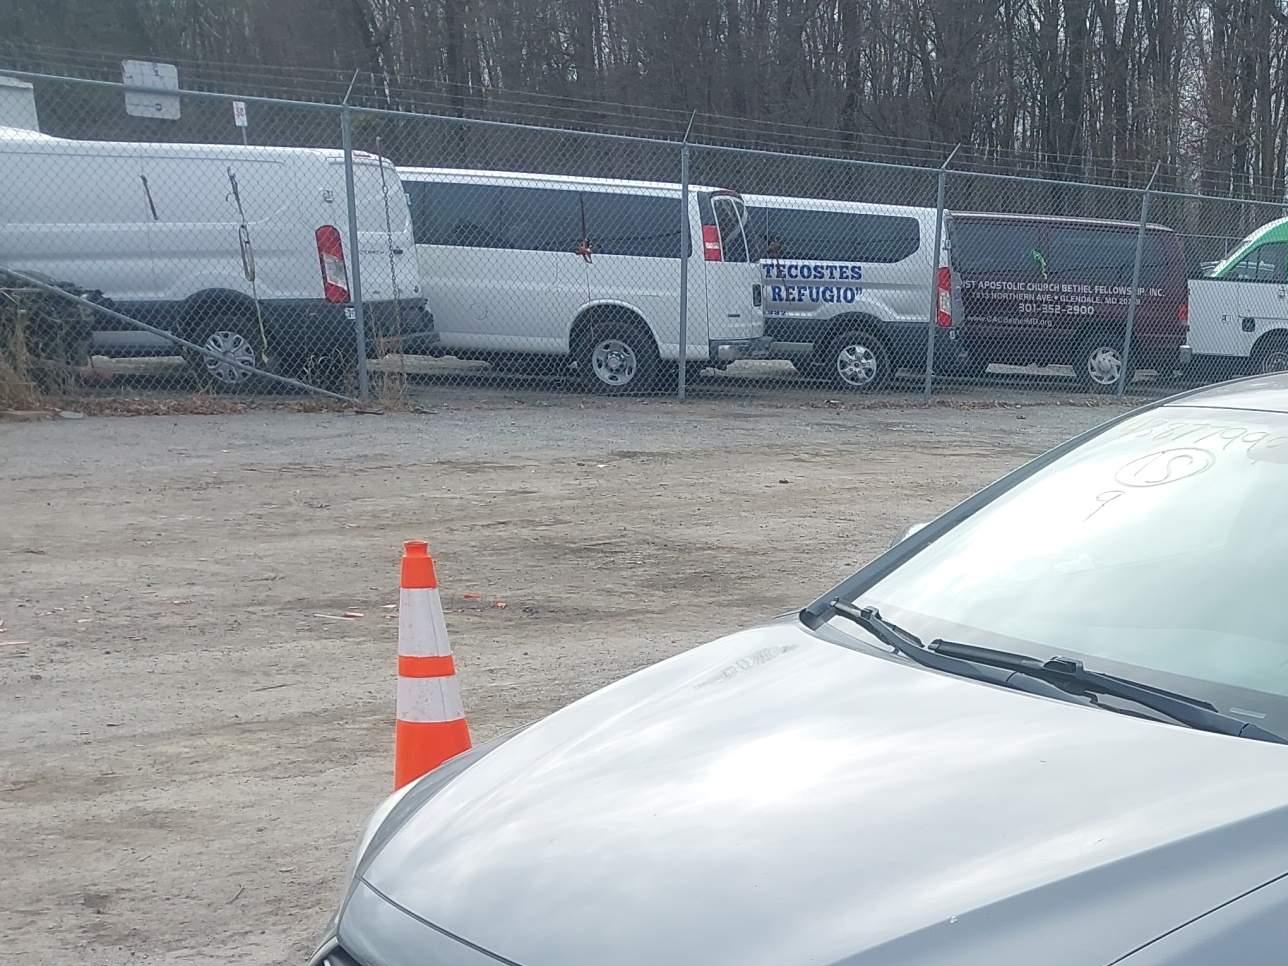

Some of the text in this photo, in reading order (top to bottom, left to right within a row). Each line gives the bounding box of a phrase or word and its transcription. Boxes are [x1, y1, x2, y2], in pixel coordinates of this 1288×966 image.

[762, 263, 862, 280] TECOSTES
[978, 280, 1025, 291] APOSTOLIC
[1027, 282, 1060, 292] CHURCH
[1062, 284, 1092, 294] BETHEL
[1018, 302, 1095, 315] 301-352-2900
